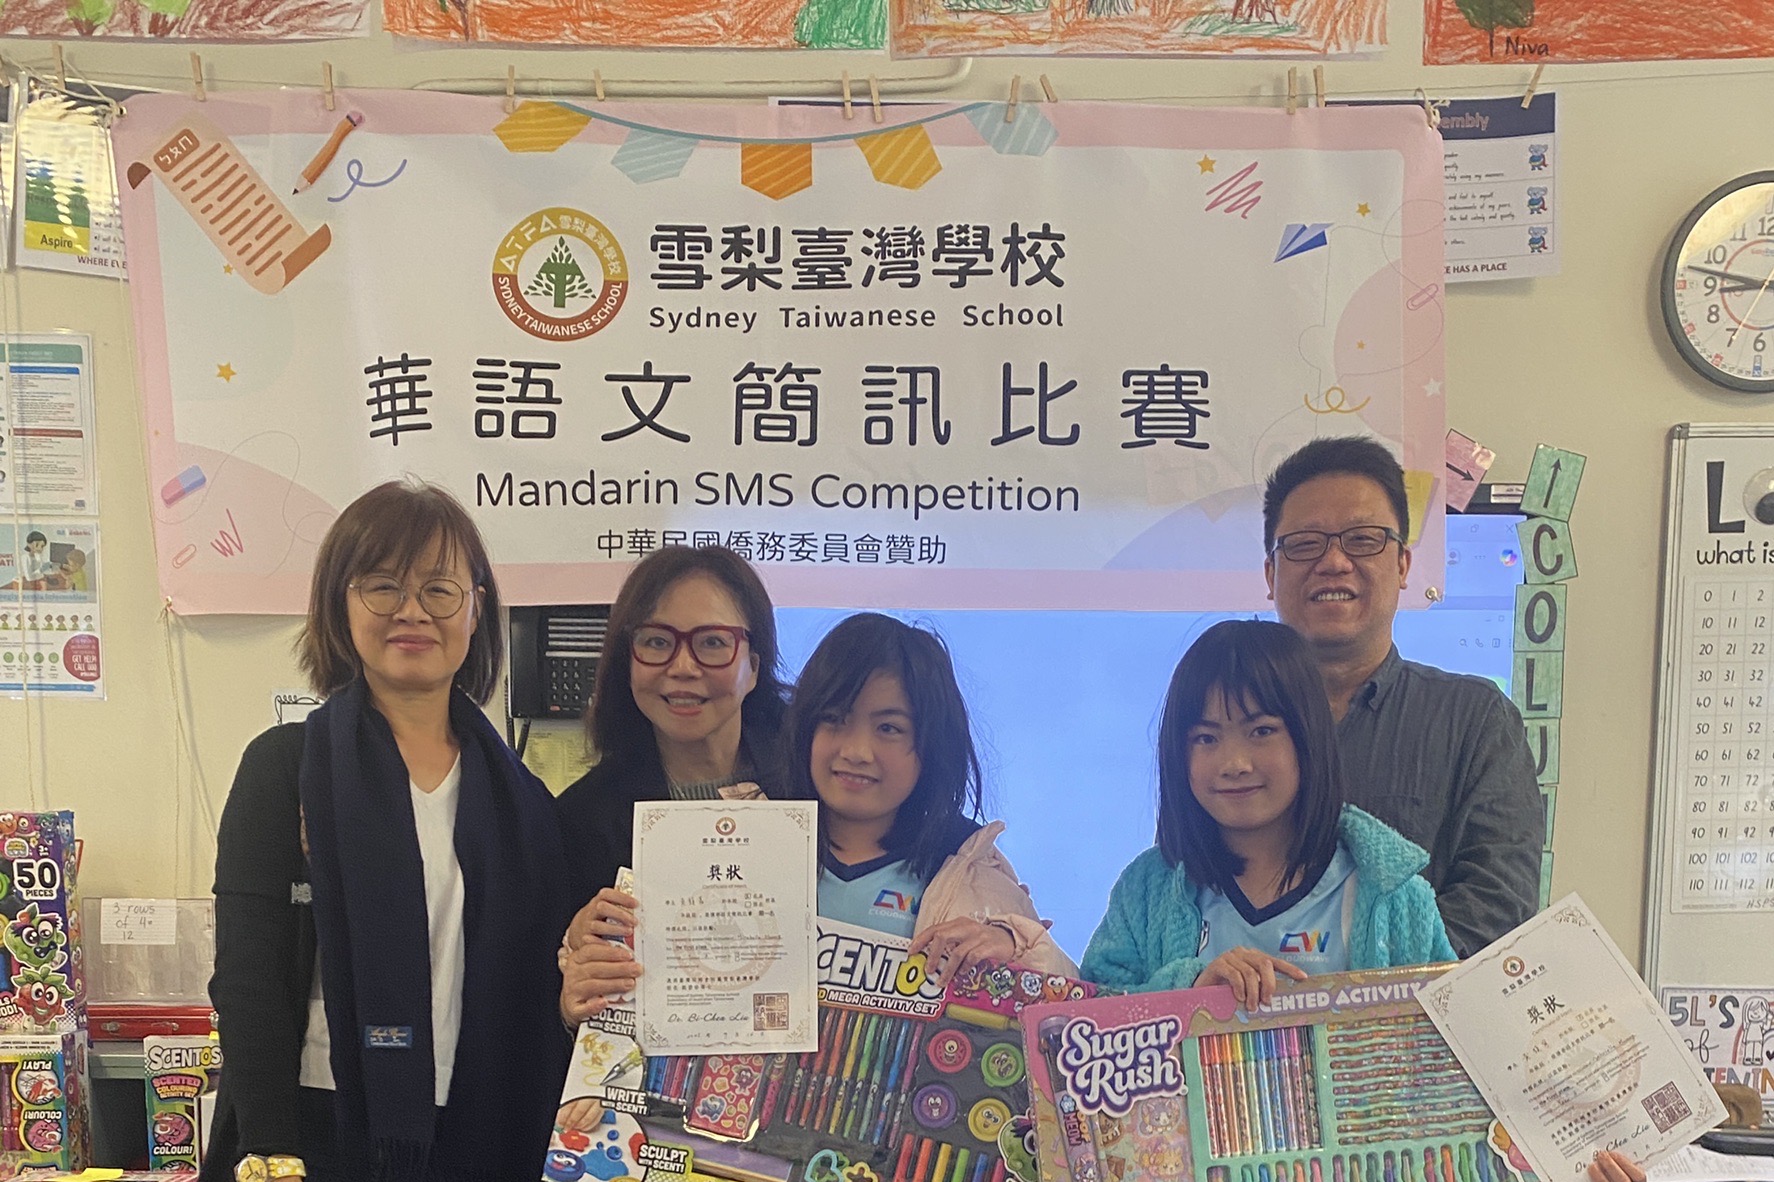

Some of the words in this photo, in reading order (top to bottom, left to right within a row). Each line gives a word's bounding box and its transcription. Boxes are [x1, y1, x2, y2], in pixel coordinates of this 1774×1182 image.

[1506, 36, 1549, 56] Niva
[1438, 113, 1489, 130] embly
[40, 234, 73, 248] Aspire
[77, 256, 108, 266] WHERE
[650, 221, 1066, 292] 雪梨臺灣學校
[1704, 245, 1727, 264] 10
[1453, 265, 1470, 273] HAS
[1472, 264, 1478, 272] A
[1481, 263, 1507, 272] PLACE
[1704, 276, 1717, 296] 9
[498, 276, 526, 320] SYDNEY
[524, 315, 594, 336] TAIWANESE
[591, 282, 622, 326] SCHOOL
[650, 306, 758, 333] Sydney
[780, 305, 936, 328] Taiwanese
[962, 303, 1064, 328] School
[1707, 304, 1720, 323] 8
[1726, 328, 1738, 347] 7
[1753, 332, 1766, 352] 6
[365, 352, 1210, 450] 華語文簡訊比賽
[476, 471, 680, 508] Mandarin
[694, 471, 795, 508] SMS
[810, 473, 1080, 520] Competition
[1697, 540, 1756, 565] what
[1704, 591, 1712, 602] 0
[1732, 590, 1736, 602] 1
[1757, 590, 1764, 601] 2
[1702, 617, 1713, 628] 10
[1728, 617, 1737, 628] 11
[1755, 616, 1765, 628] 12
[1699, 644, 1713, 655] 20
[1726, 643, 1736, 655] 21
[1751, 643, 1765, 655] 22
[74, 663, 86, 671] CALL
[1697, 670, 1712, 682] 30
[1724, 670, 1735, 681] 31
[1750, 670, 1763, 681] 32
[1696, 696, 1711, 708] 40
[1723, 696, 1734, 707] 41
[1748, 696, 1762, 707] 42
[1696, 723, 1710, 734] 50
[1722, 722, 1732, 734] 51
[1747, 722, 1761, 733] 52
[1695, 749, 1709, 761] 60
[1722, 749, 1731, 760] 61
[1746, 749, 1760, 760] 62
[1694, 775, 1708, 787] 70
[1720, 775, 1730, 786] 71
[1746, 775, 1759, 786] 72
[1692, 801, 1706, 813] 80
[1718, 801, 1728, 812] 81
[1744, 801, 1757, 812] 82
[1691, 827, 1705, 839] 90
[1717, 827, 1728, 838] 91
[1743, 827, 1756, 838] 92
[1688, 853, 1707, 865] 100
[1715, 853, 1731, 864] 101
[1740, 852, 1757, 864] 102
[16, 862, 56, 888] 50
[1689, 879, 1704, 891] 110
[1714, 879, 1728, 890] 111
[1739, 878, 1755, 890] 112
[128, 904, 156, 914] rows
[116, 917, 128, 928] of
[123, 931, 134, 940] 12
[818, 933, 945, 999] CENTO
[828, 991, 860, 1005] MEGA
[862, 995, 914, 1013] ACTIVITY
[914, 1003, 938, 1016] SET
[1249, 991, 1331, 1013] CENTED
[1335, 982, 1421, 1005] ACTIVITY
[592, 1009, 636, 1026] OLOUR
[1670, 995, 1740, 1029] 5L'S
[1065, 1019, 1176, 1068] Sugar
[23, 1060, 51, 1070] PLAY!
[150, 1046, 223, 1070] SCENTOS
[153, 1076, 201, 1087] SCENTED
[1074, 1050, 1178, 1104] Rush
[607, 1087, 646, 1104] WRITE
[25, 1110, 62, 1120] COLOUR!
[616, 1101, 647, 1115] SCENT!
[153, 1144, 193, 1155] COLOUR!
[640, 1144, 687, 1162] SCULPT
[653, 1159, 684, 1173] SCENT!
